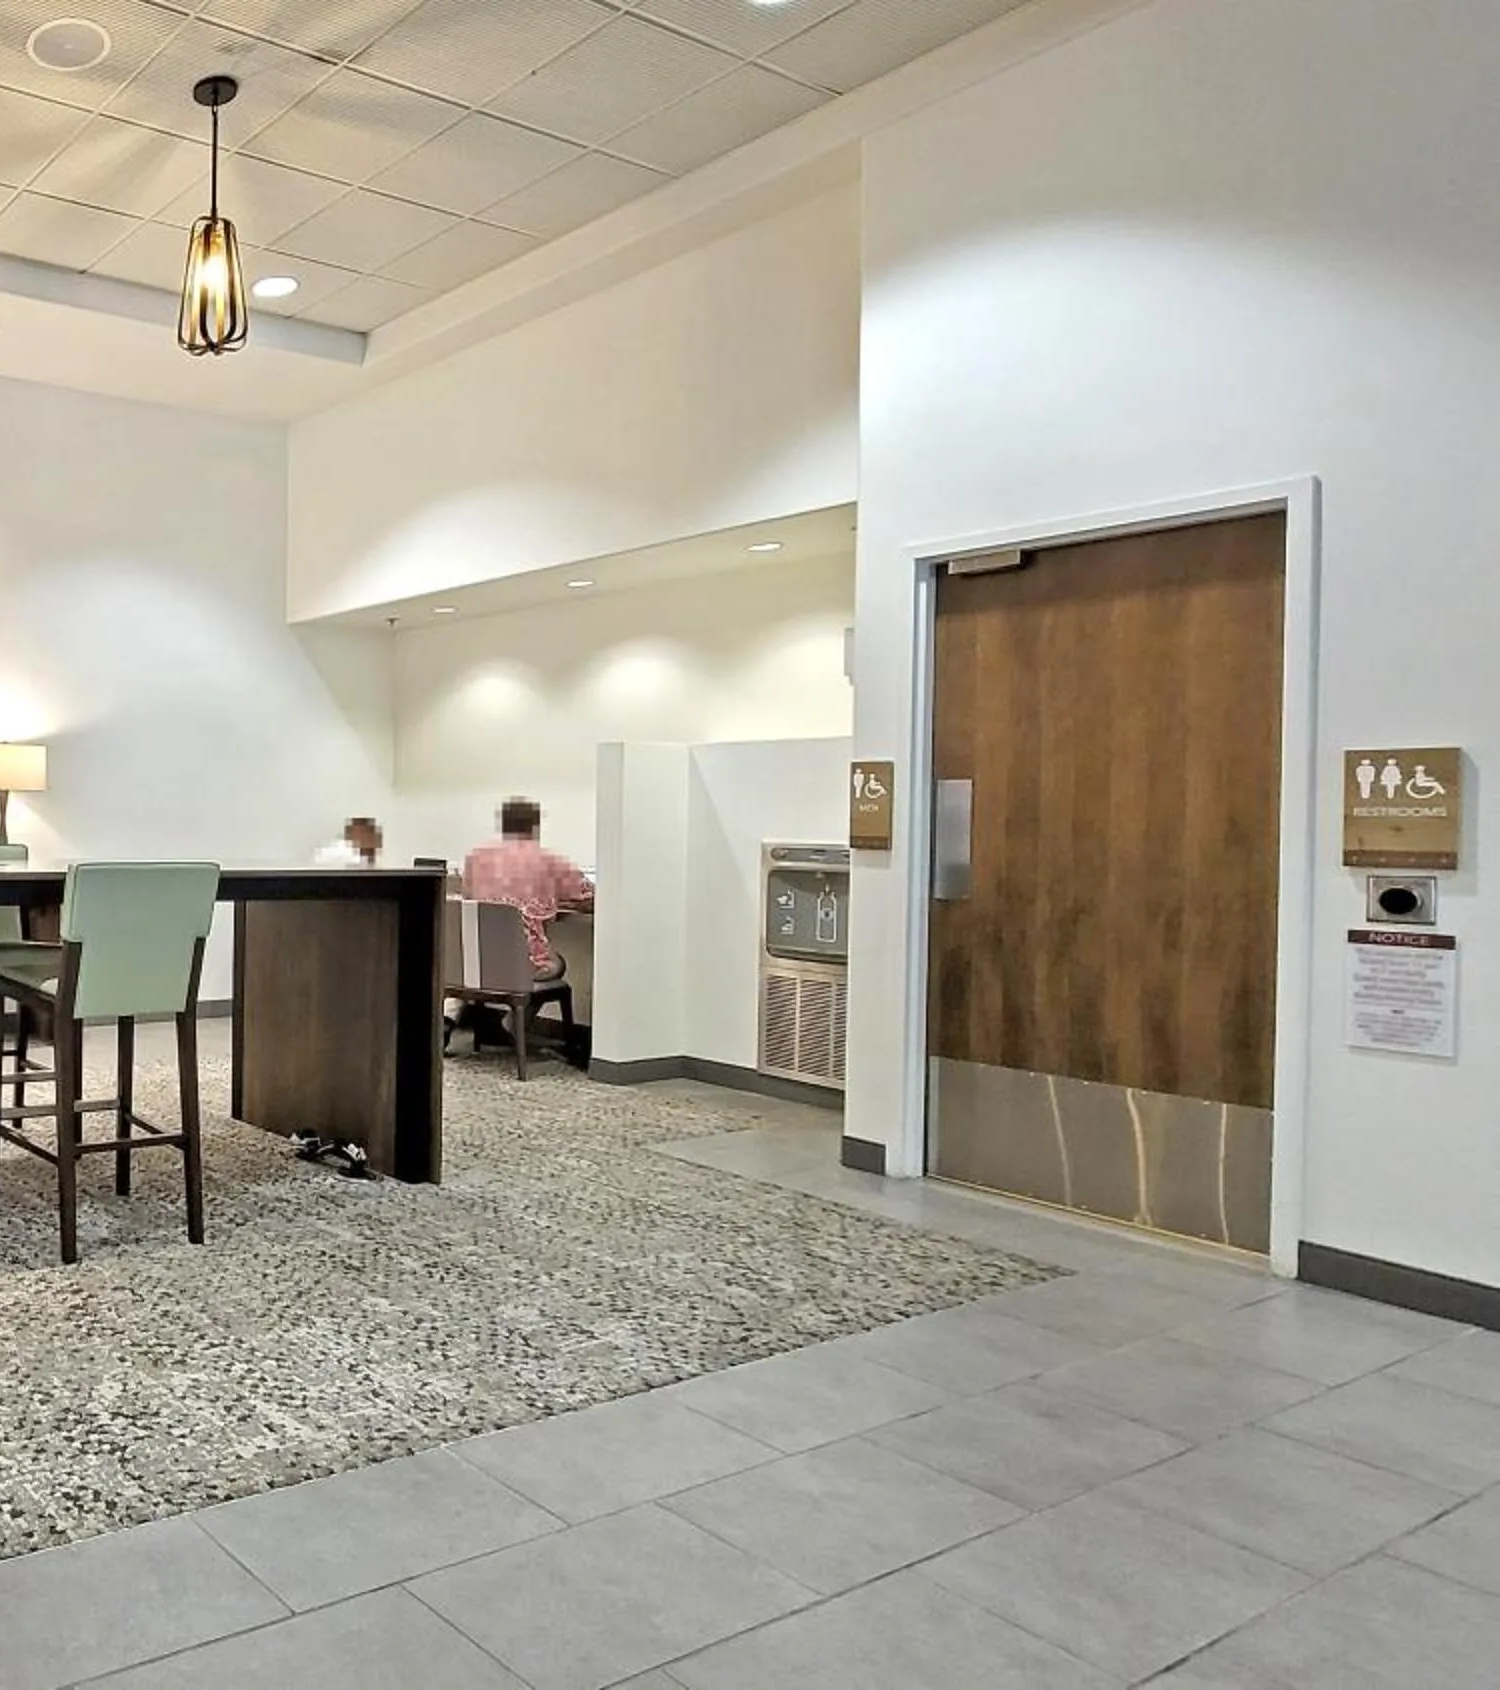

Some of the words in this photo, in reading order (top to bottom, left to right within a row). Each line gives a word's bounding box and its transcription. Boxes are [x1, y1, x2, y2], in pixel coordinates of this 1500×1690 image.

[859, 803, 879, 813] MEN
[1353, 806, 1447, 817] RESTROOMS
[1368, 931, 1430, 945] NOTICE
